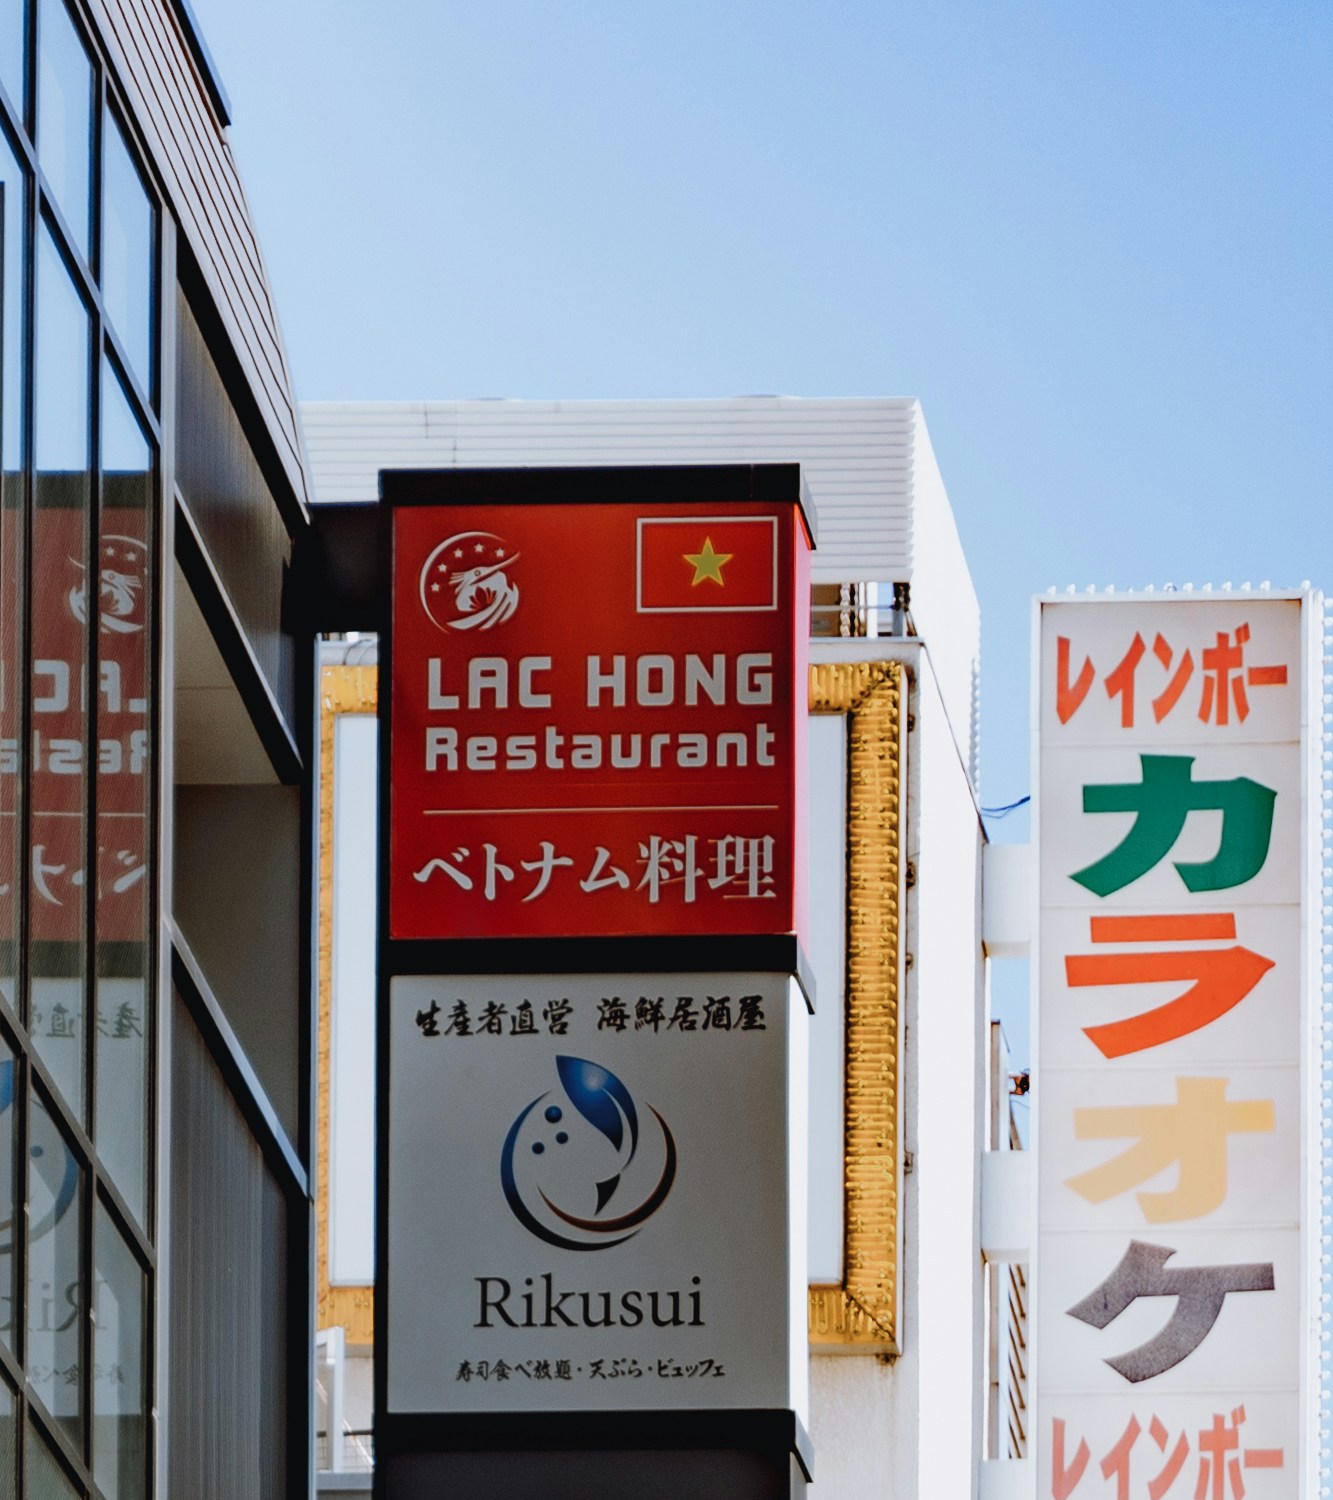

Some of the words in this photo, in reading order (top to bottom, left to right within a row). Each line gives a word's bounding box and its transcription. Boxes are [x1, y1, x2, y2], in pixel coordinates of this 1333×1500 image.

[427, 656, 552, 711] LAC
[587, 653, 773, 707] HONG
[1057, 621, 1288, 729] レインボー
[425, 723, 776, 772] Restaurant
[413, 834, 777, 904] ベトナム料理
[415, 998, 573, 1037] 生産者直営
[596, 995, 767, 1034] 海鮮居酒屋
[1063, 752, 1278, 1384] カラオケ
[473, 1272, 706, 1329] Rikusui
